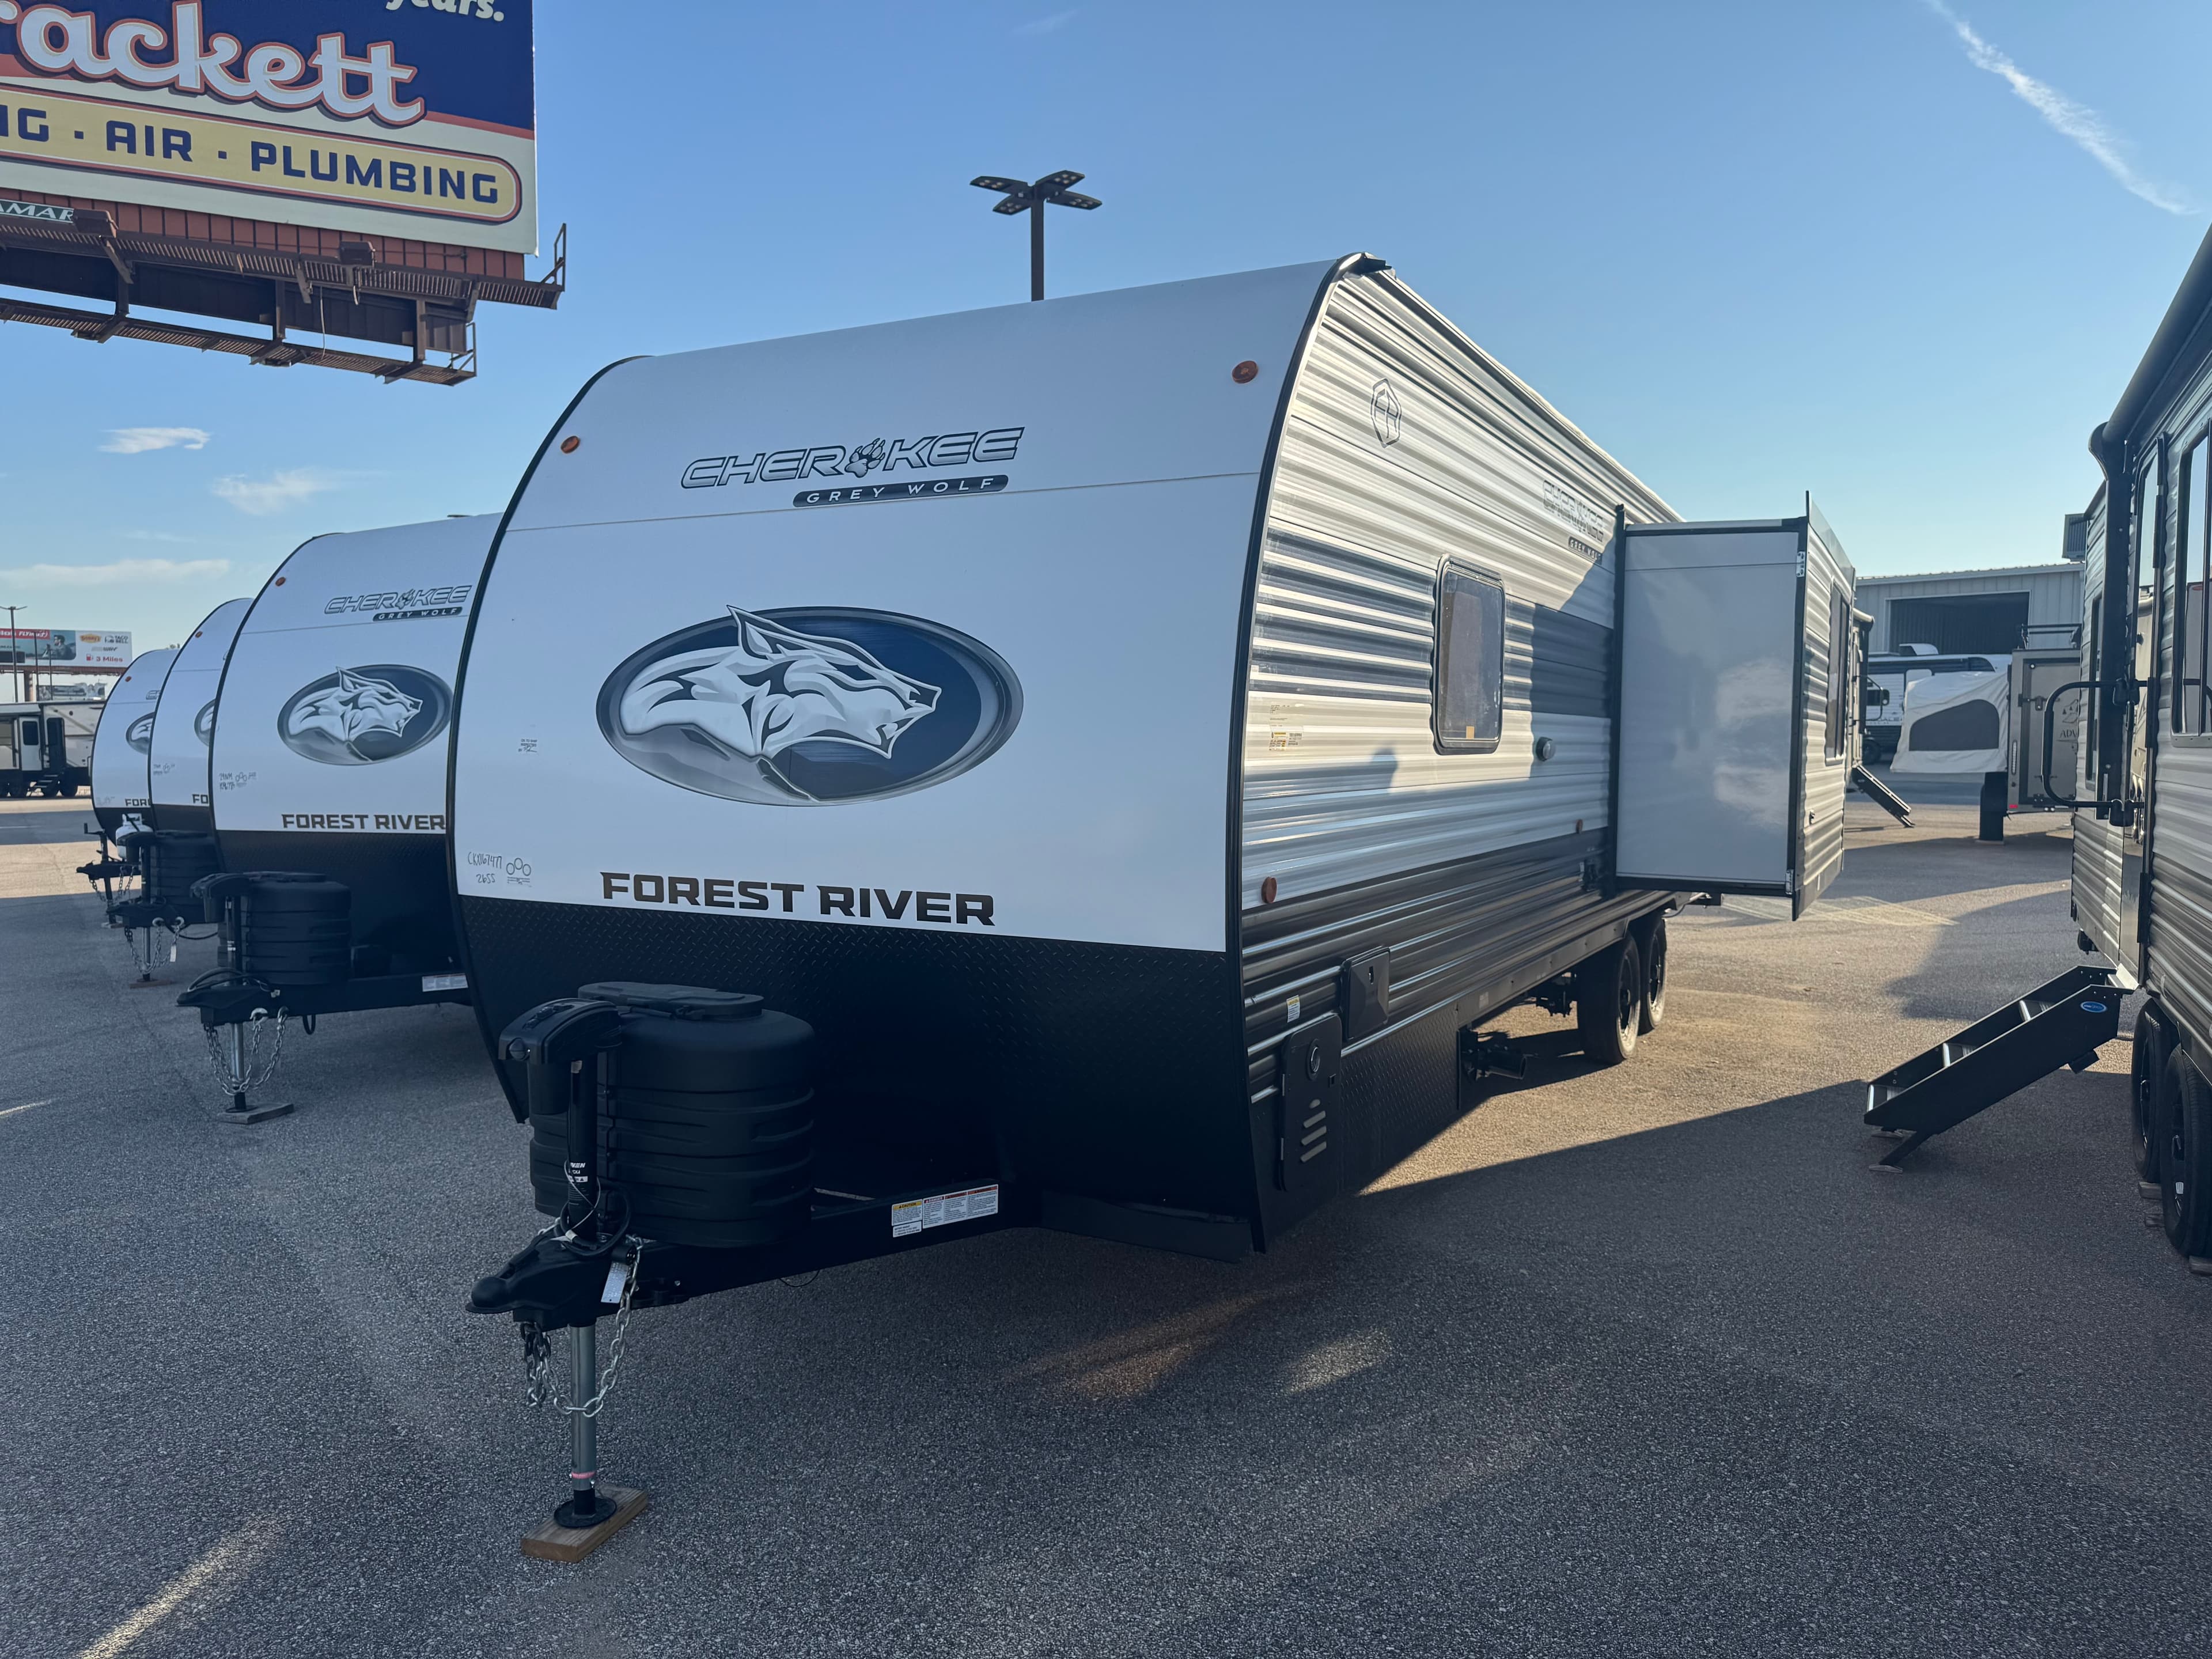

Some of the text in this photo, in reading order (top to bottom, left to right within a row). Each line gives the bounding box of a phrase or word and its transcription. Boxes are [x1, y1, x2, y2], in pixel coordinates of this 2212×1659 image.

[106, 120, 193, 162] AIR
[251, 141, 498, 203] PLUMBING
[0, 203, 74, 221] MAR
[806, 478, 995, 503] GREY WOLF
[1570, 539, 1585, 553] GREY
[421, 608, 457, 616] WOLF
[282, 814, 446, 830] FOREST RIVER
[600, 872, 995, 926] FOREST RIVER
